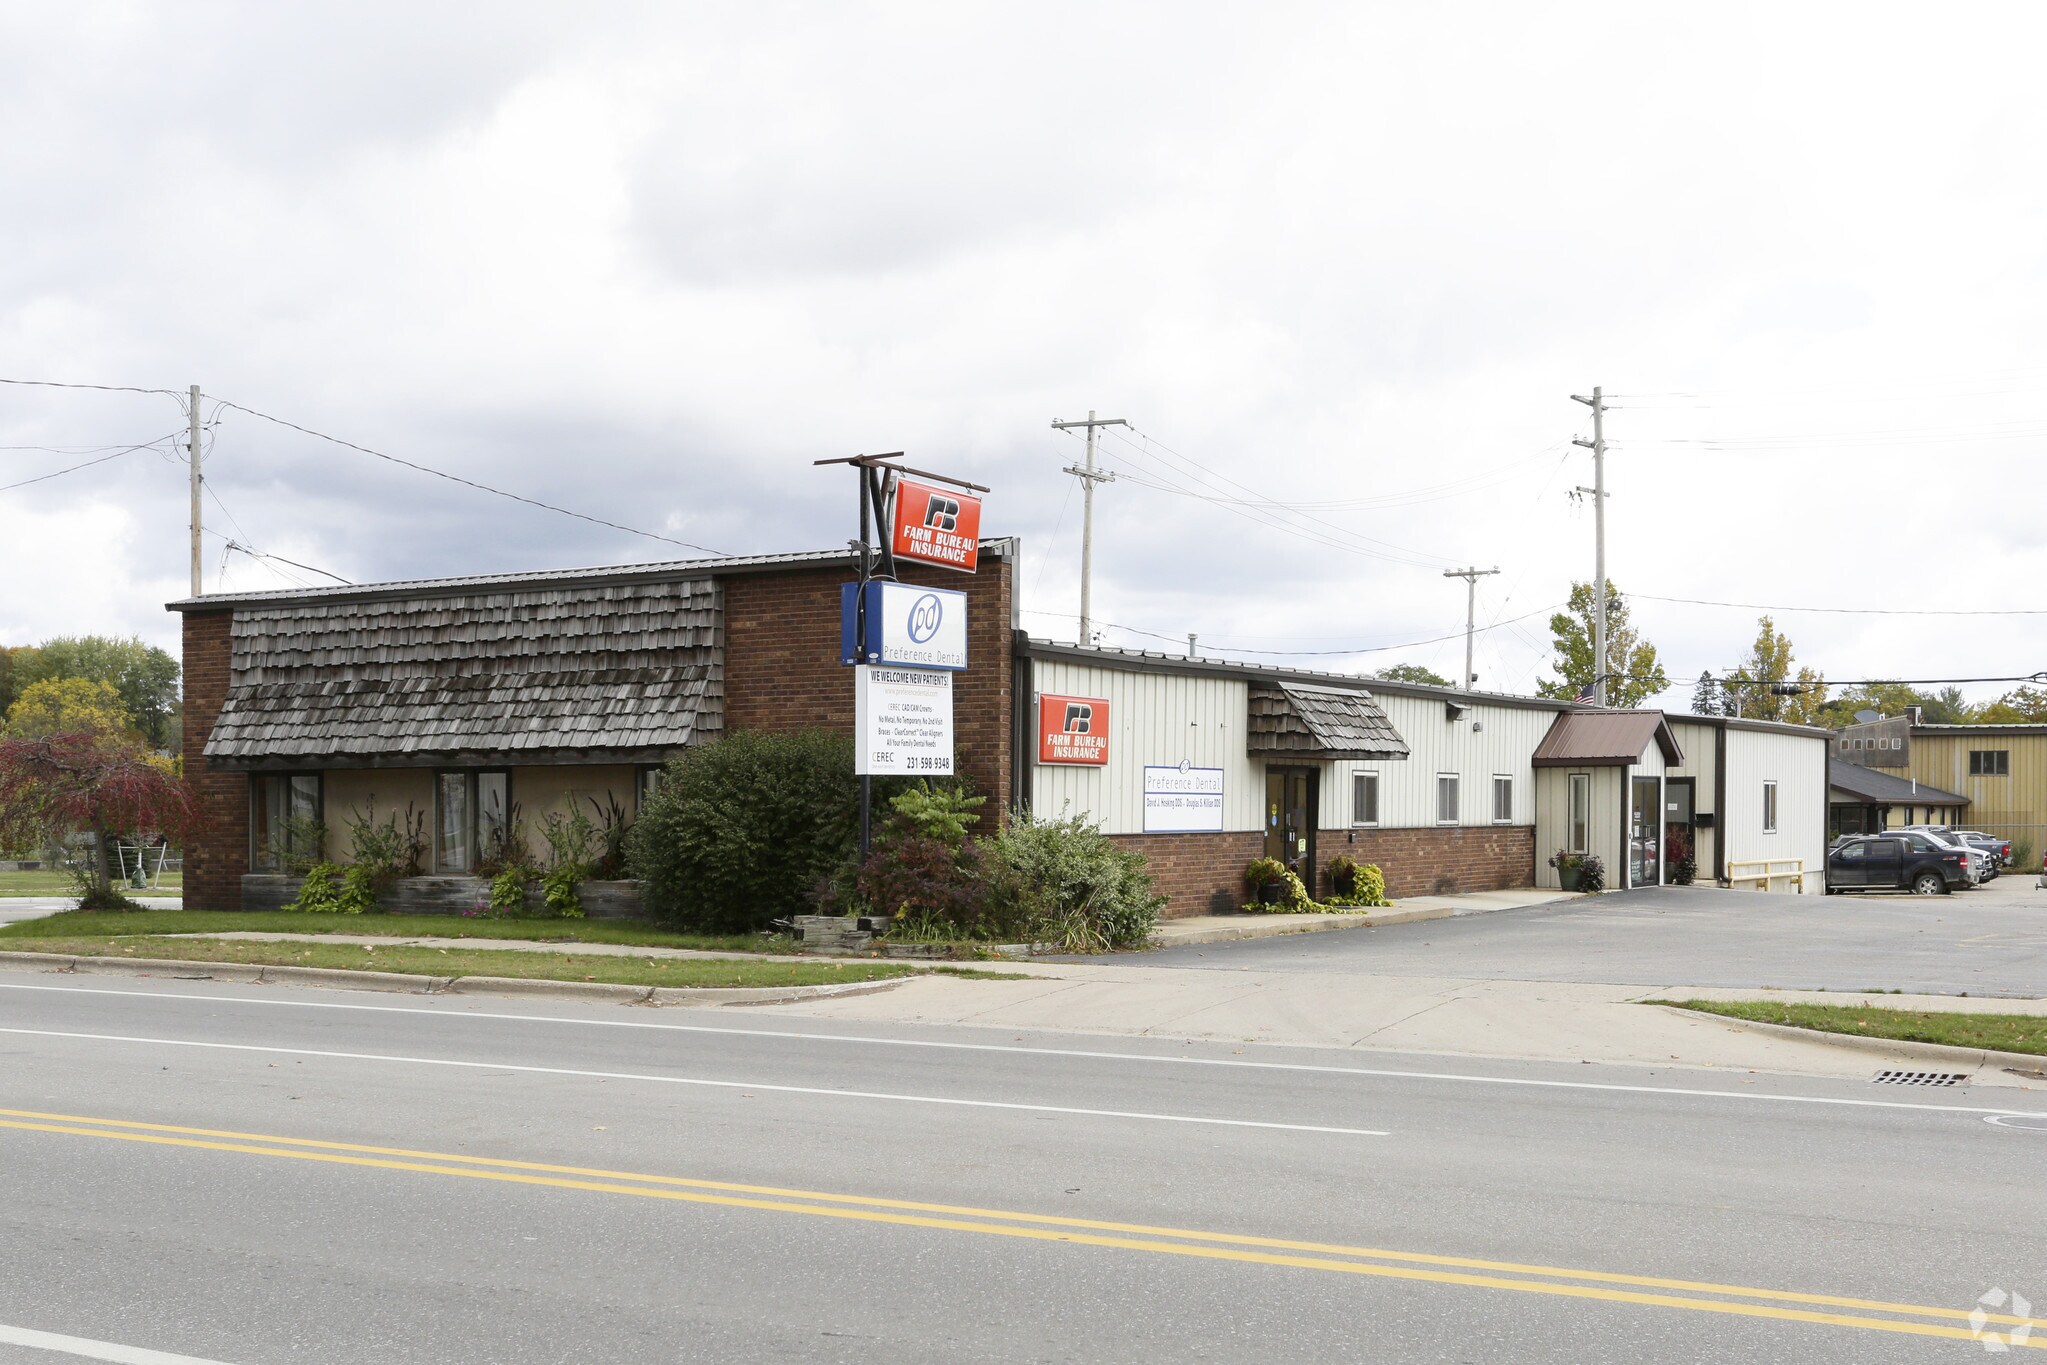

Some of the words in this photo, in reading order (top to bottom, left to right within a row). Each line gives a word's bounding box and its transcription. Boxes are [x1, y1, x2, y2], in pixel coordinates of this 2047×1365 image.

[903, 524, 932, 543] FARM
[936, 531, 976, 552] BUREAU
[910, 540, 967, 563] INSURANCE
[884, 645, 932, 662] Preference
[937, 650, 964, 665] Dental
[871, 670, 880, 682] WE
[881, 671, 909, 684] WELCOME
[909, 673, 922, 685] NEW
[923, 674, 949, 687] PATIENTS!
[878, 715, 884, 723] No
[896, 716, 902, 724] No
[878, 727, 891, 736] Braces
[892, 739, 900, 747] Your
[1047, 733, 1071, 746] FARM
[1074, 735, 1107, 748] BUREAU
[872, 752, 894, 763] CEREC
[1053, 746, 1101, 759] INSURANCE
[1147, 775, 1192, 790] Preference
[1195, 776, 1220, 790] Dental
